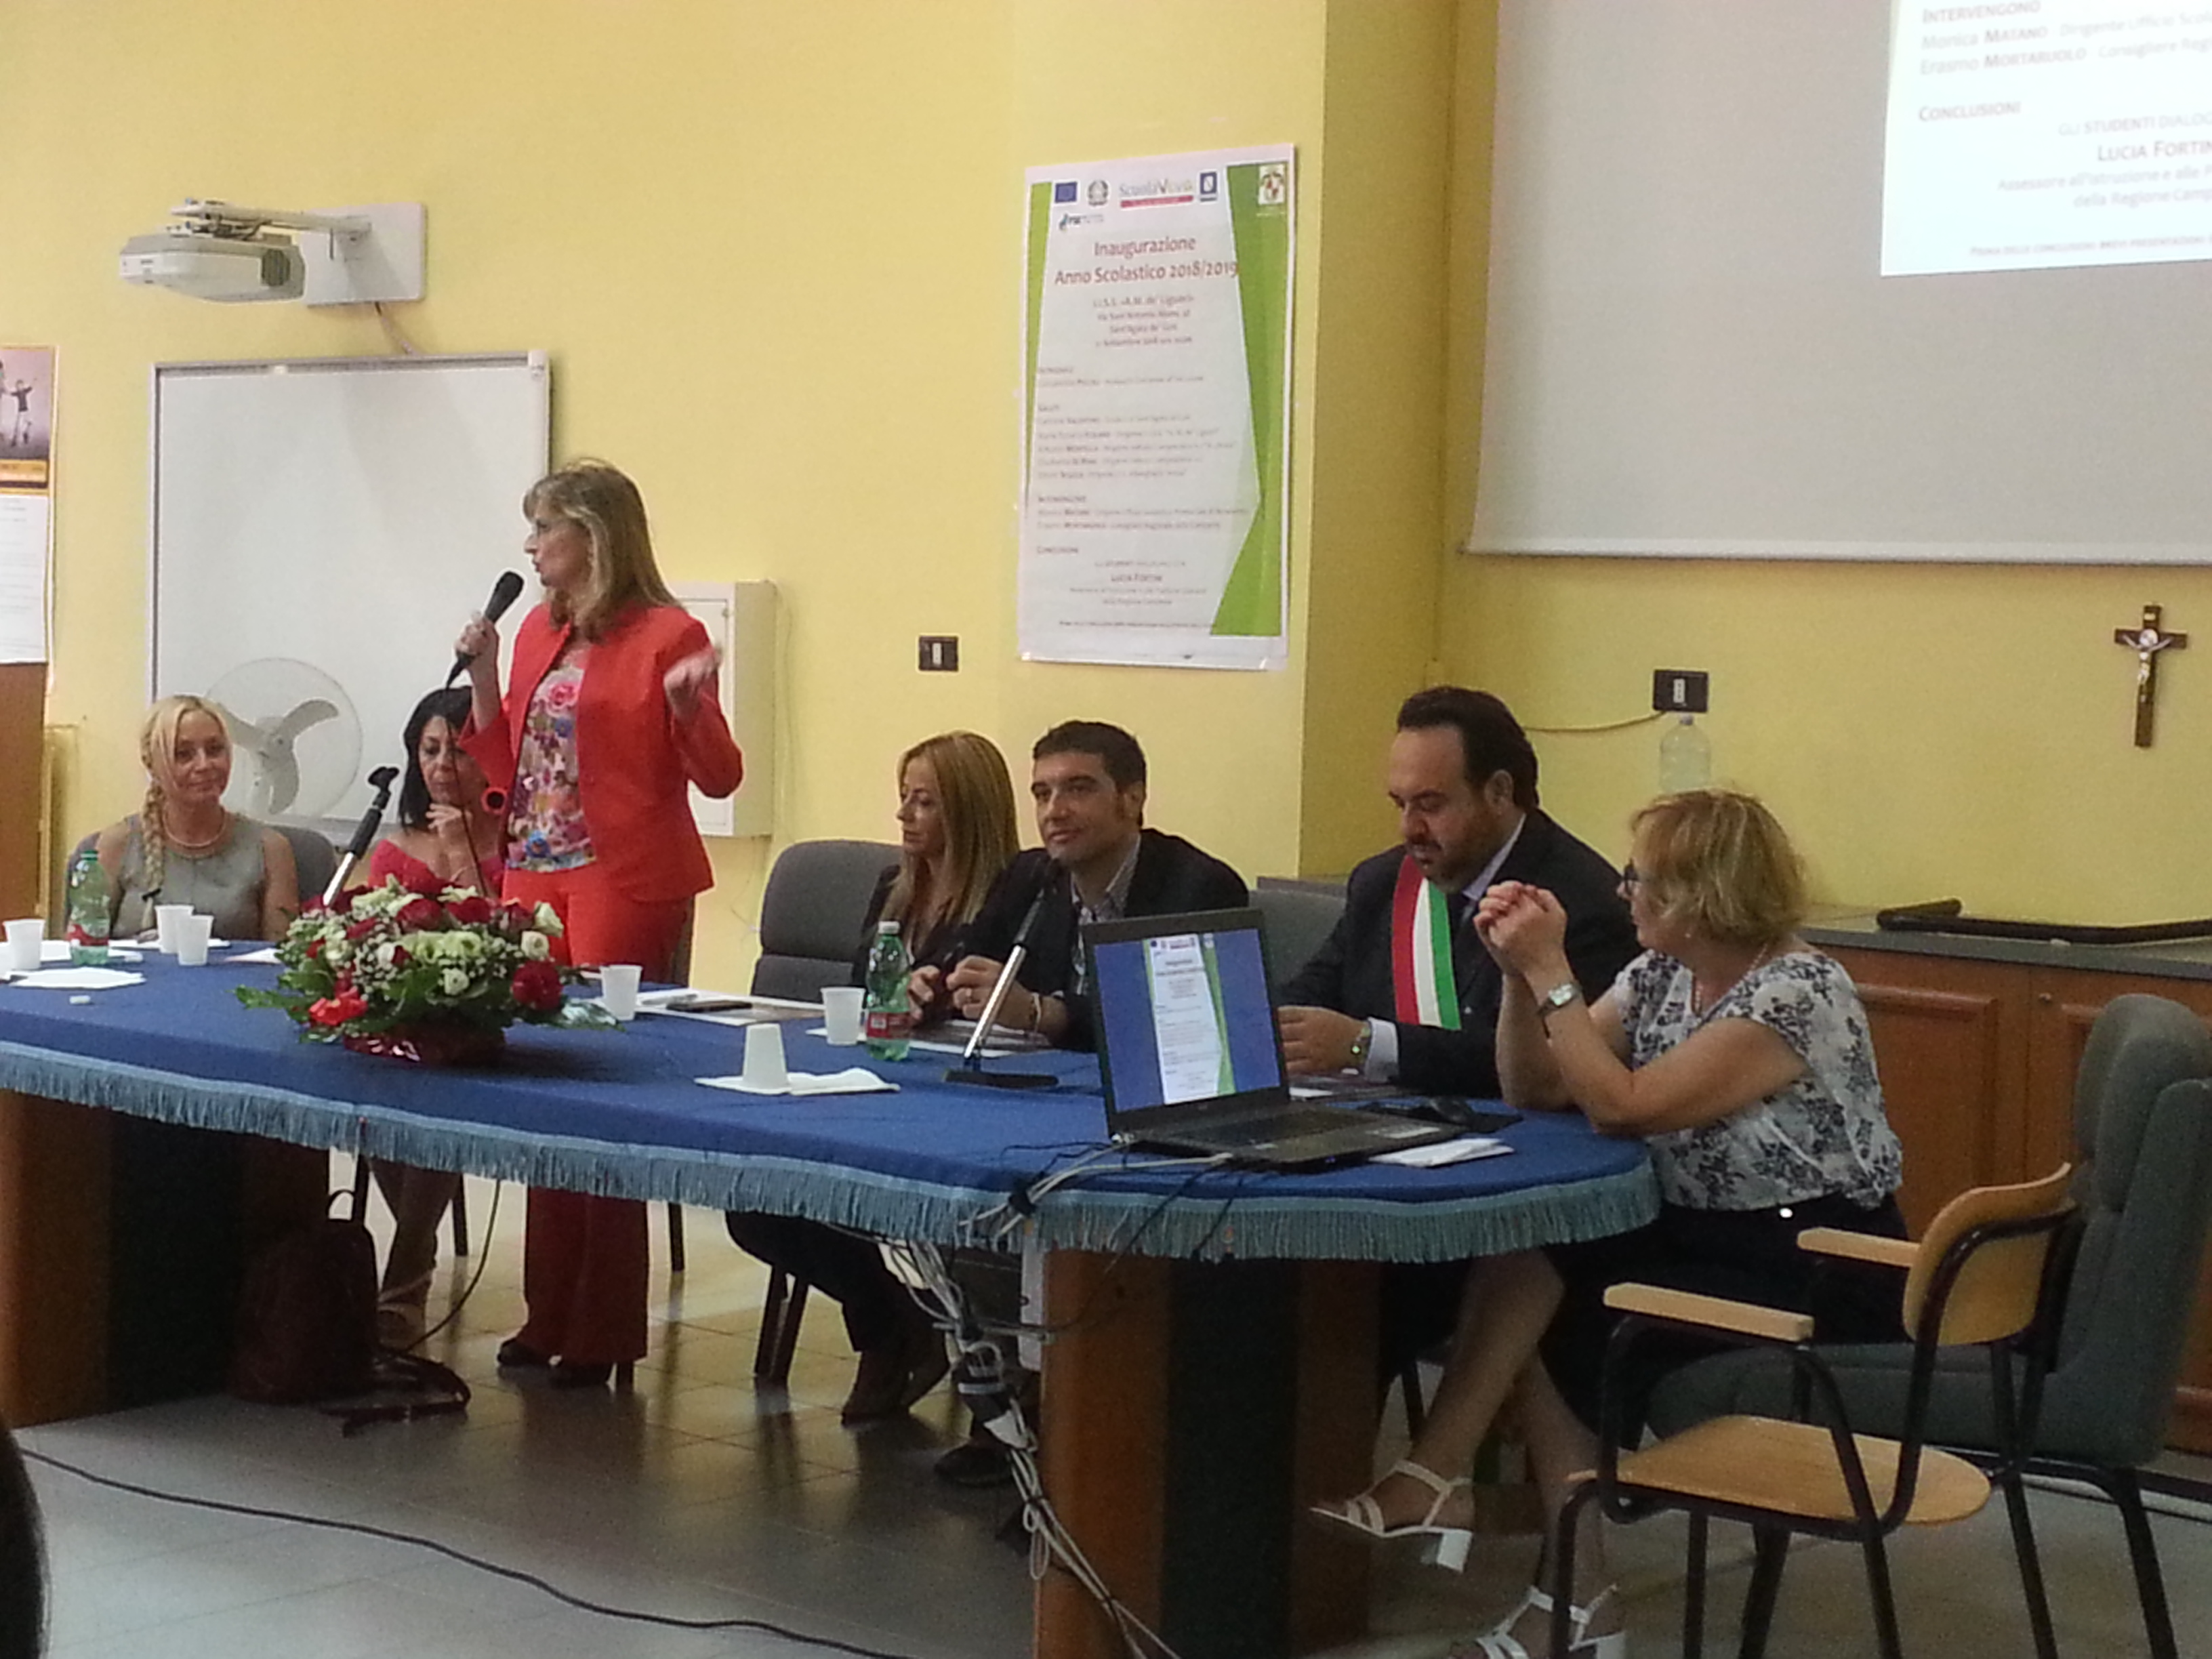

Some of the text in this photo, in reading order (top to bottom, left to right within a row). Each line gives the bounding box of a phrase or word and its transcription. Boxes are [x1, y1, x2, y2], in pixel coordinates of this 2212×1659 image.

[1922, 0, 2041, 24] INTERVENGONO
[1919, 101, 2022, 122] CONCLUSIONI
[2097, 144, 2148, 162] LUCIA
[1094, 237, 1196, 259] Inaugurazione
[1054, 260, 1239, 285] Anno Scolastico 2018/2019
